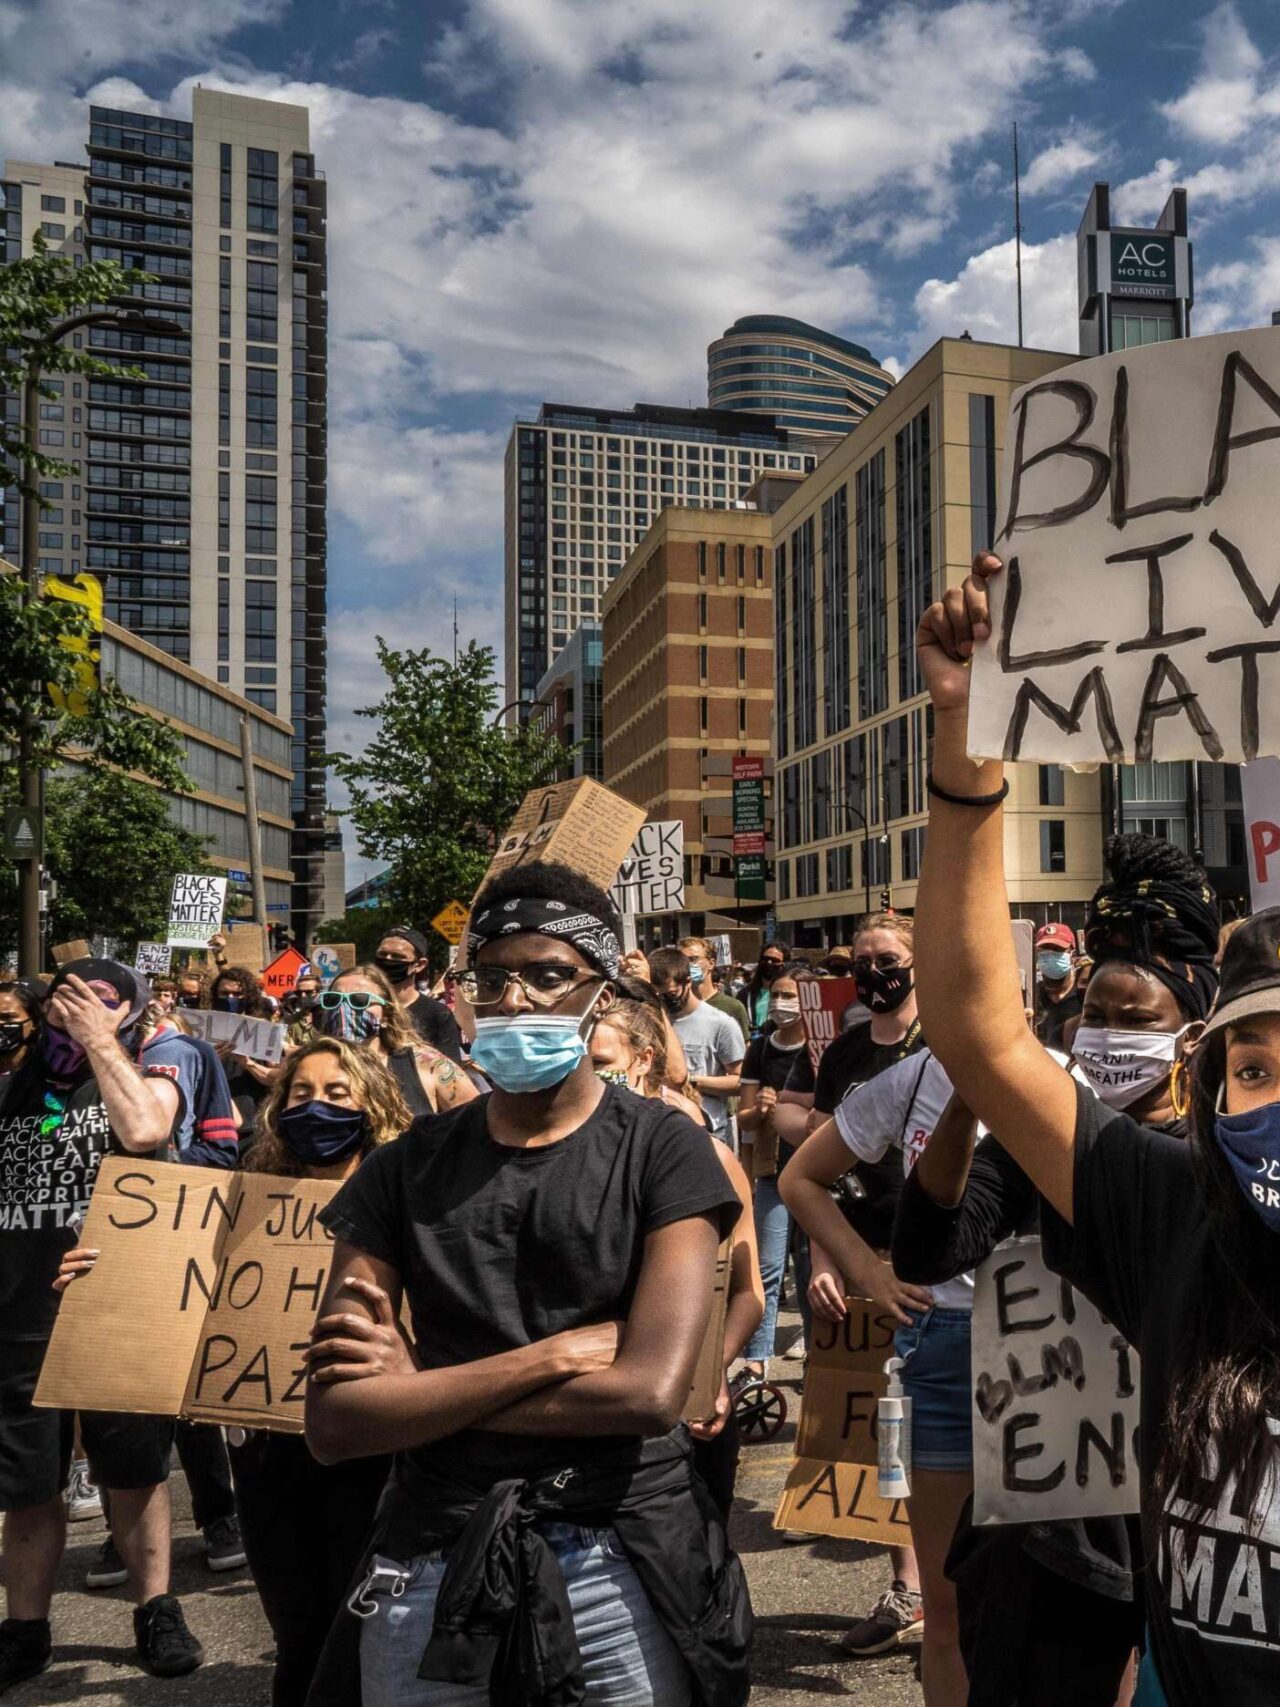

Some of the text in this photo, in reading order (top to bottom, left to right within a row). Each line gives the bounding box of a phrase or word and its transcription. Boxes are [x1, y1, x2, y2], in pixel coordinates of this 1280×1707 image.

[1119, 242, 1165, 266] AC
[1118, 268, 1166, 277] HOTELS
[1120, 286, 1167, 296] MARRIOTT
[175, 875, 216, 891] BLACK
[173, 889, 221, 905] LIVES
[171, 903, 220, 923] MATTER
[140, 944, 170, 954] END
[138, 953, 170, 963] POLICE
[267, 974, 294, 986] MER
[799, 981, 822, 1010] DO
[803, 1011, 835, 1039] YOU
[1090, 1052, 1136, 1065] CAN'T
[108, 1172, 336, 1241] SIN JU
[179, 1257, 263, 1312] NO
